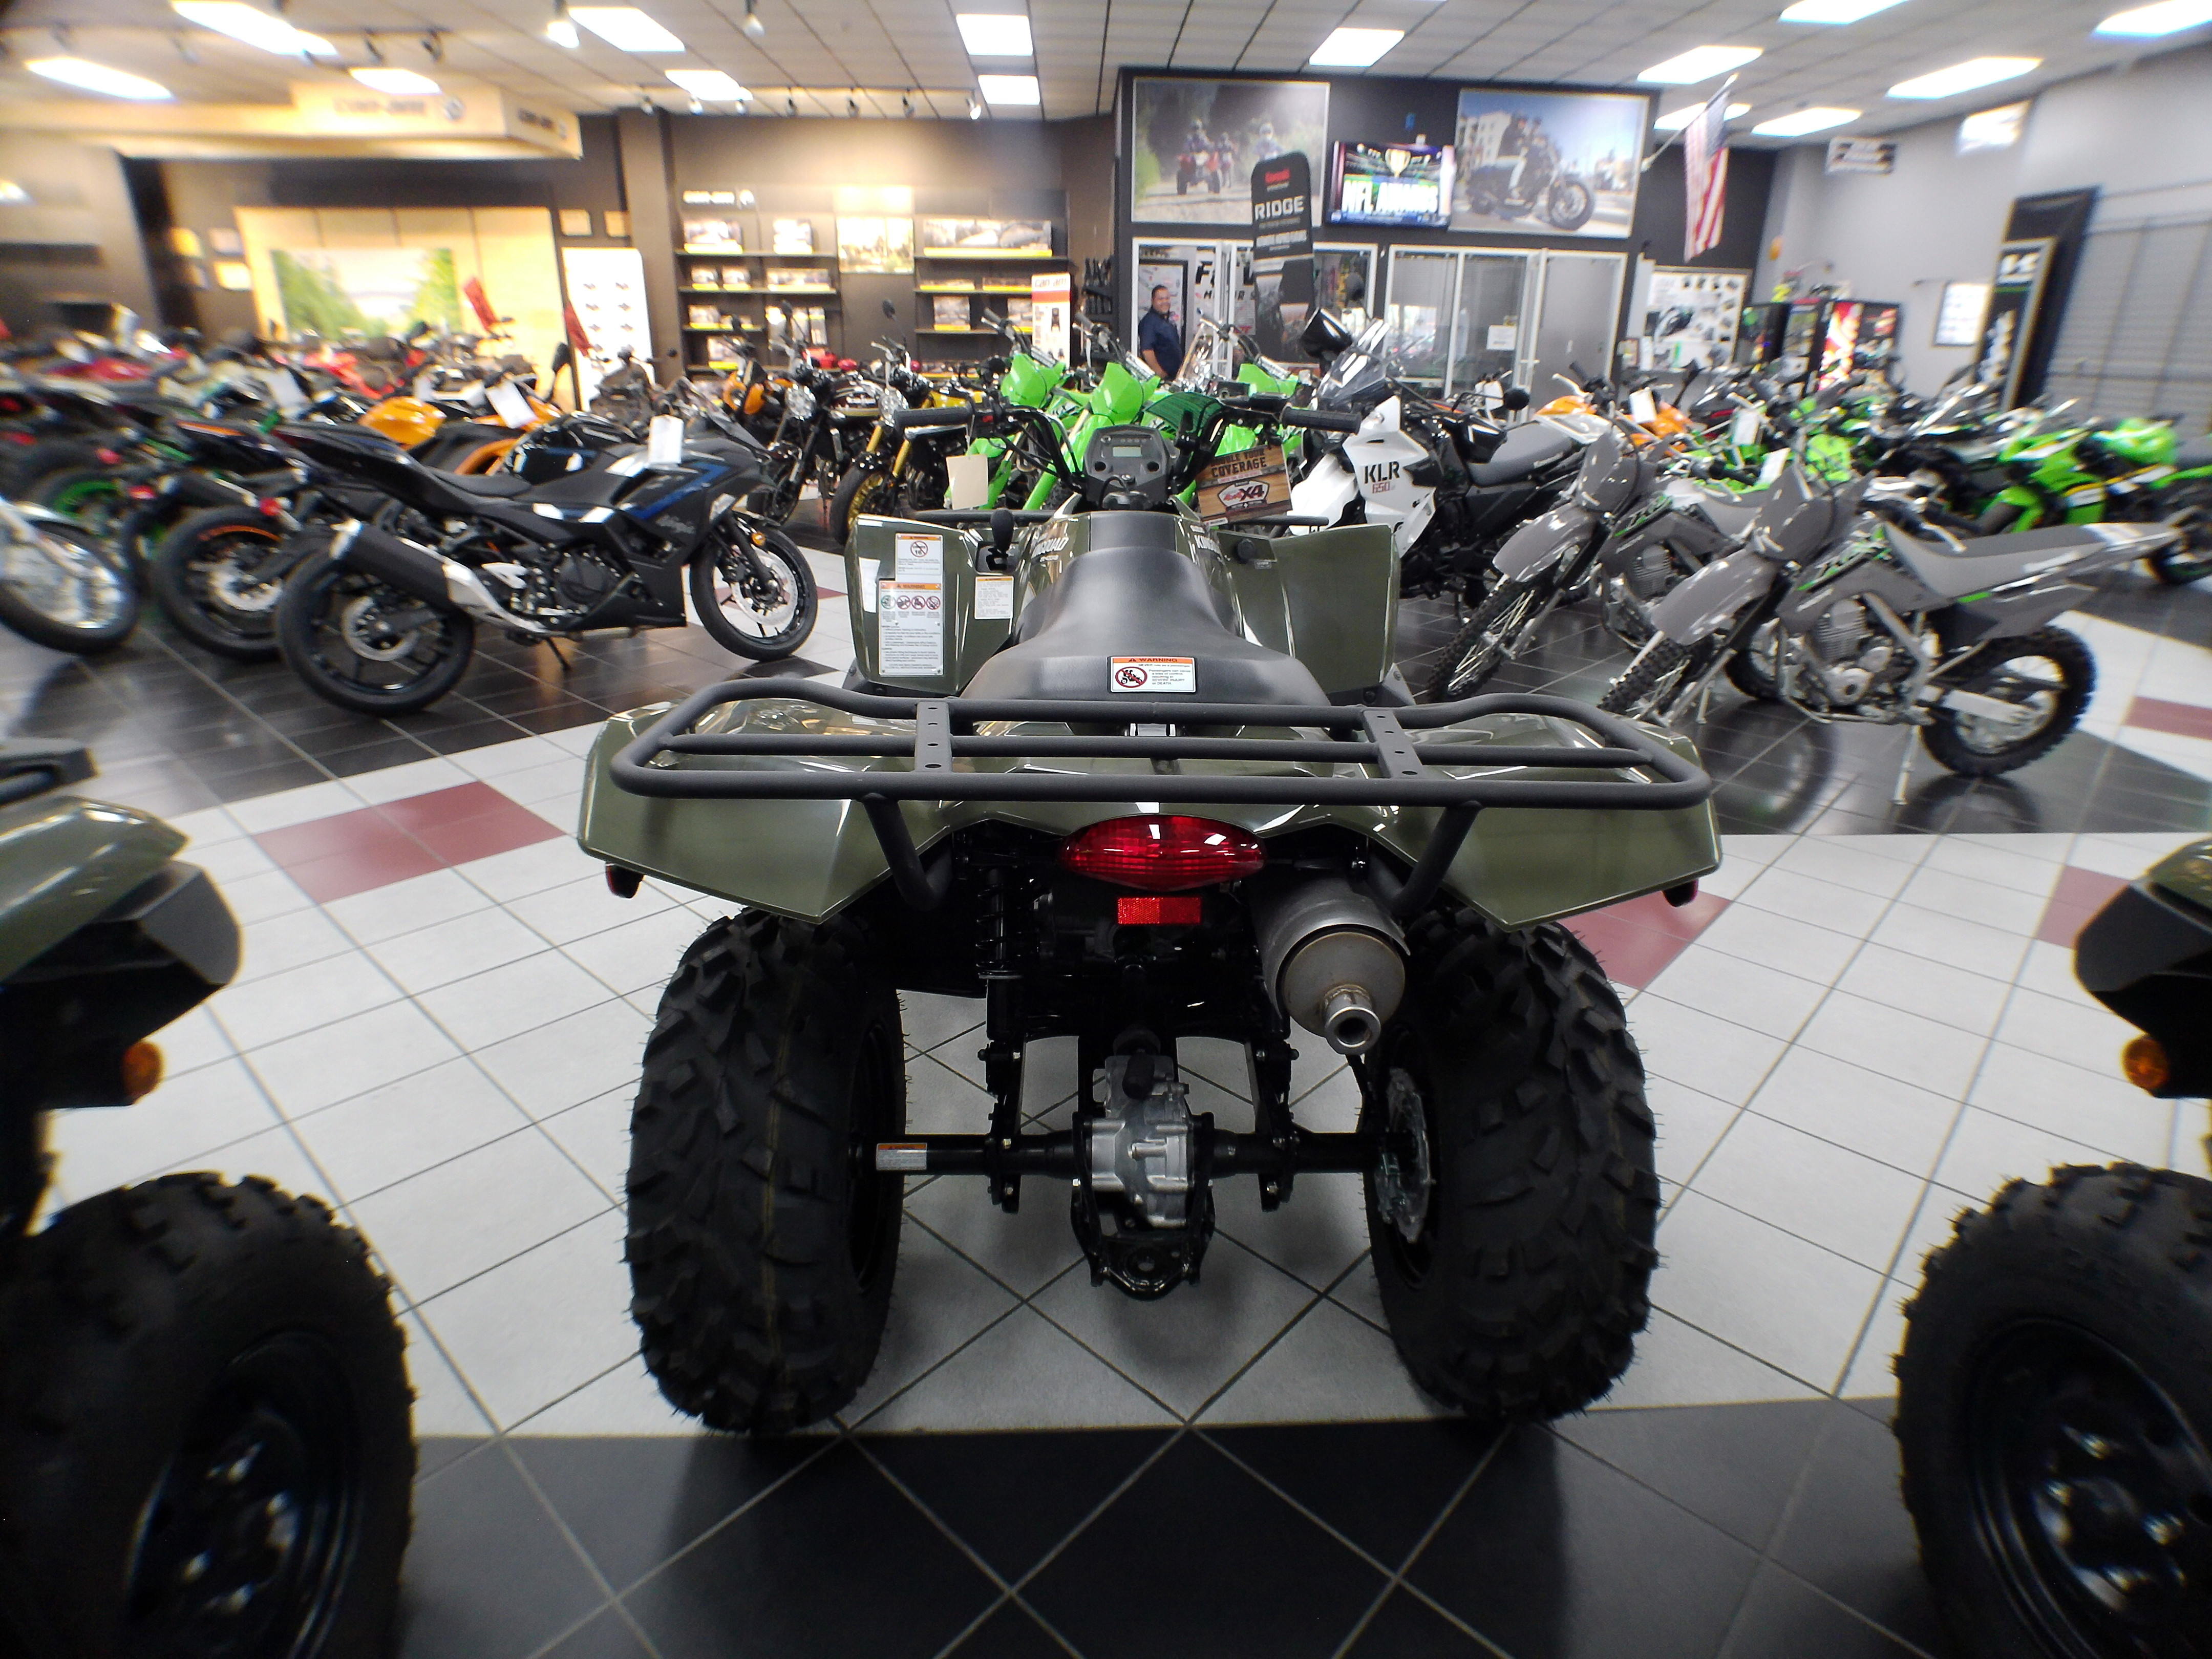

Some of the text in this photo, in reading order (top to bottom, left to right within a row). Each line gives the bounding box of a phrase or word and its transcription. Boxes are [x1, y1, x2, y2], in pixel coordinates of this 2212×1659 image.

[1254, 195, 1306, 221] RIDGE
[1342, 179, 1374, 214] NFL
[1211, 456, 1267, 478] COVERAGE
[1364, 461, 1400, 484] KLR
[1372, 482, 1390, 494] 650
